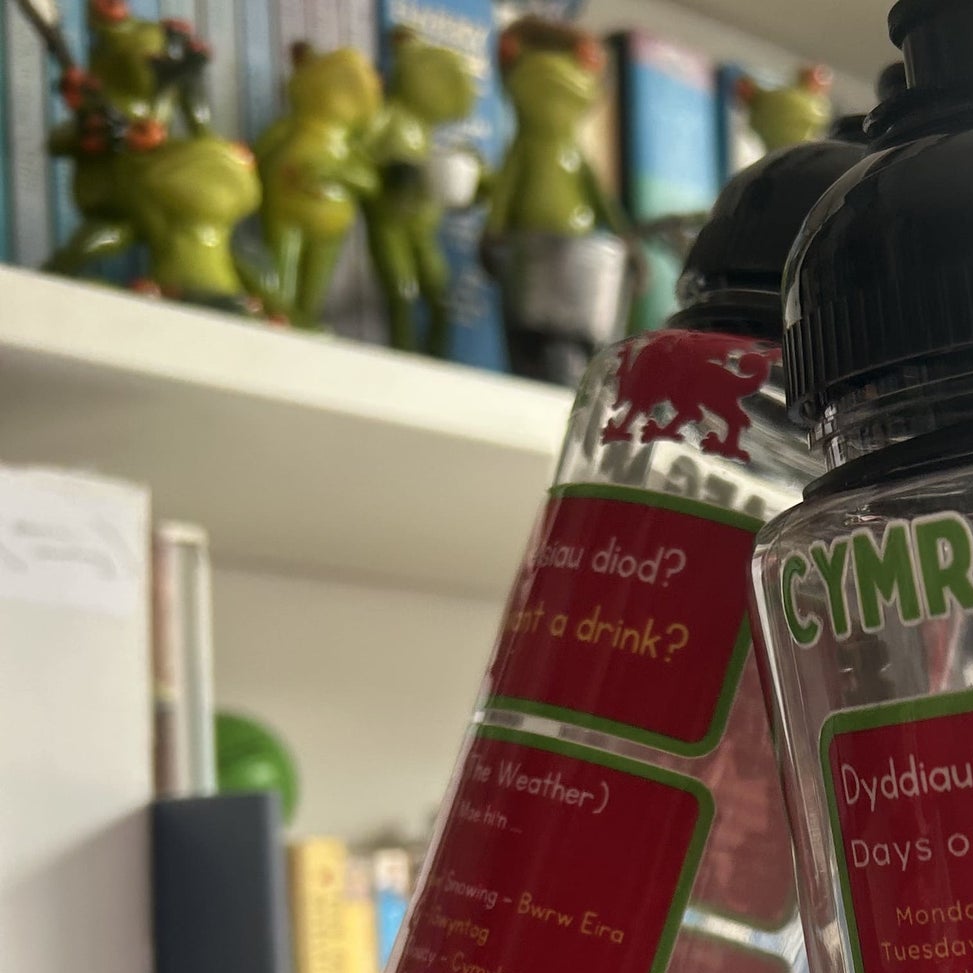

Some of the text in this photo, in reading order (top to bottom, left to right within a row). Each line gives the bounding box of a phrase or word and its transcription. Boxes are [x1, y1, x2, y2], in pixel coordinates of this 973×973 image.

[591, 536, 686, 587] diod?
[550, 613, 569, 637] a
[576, 605, 689, 662] drink?
[850, 834, 932, 872] Days
[517, 892, 574, 928] Bwrw
[580, 911, 625, 945] Eira
